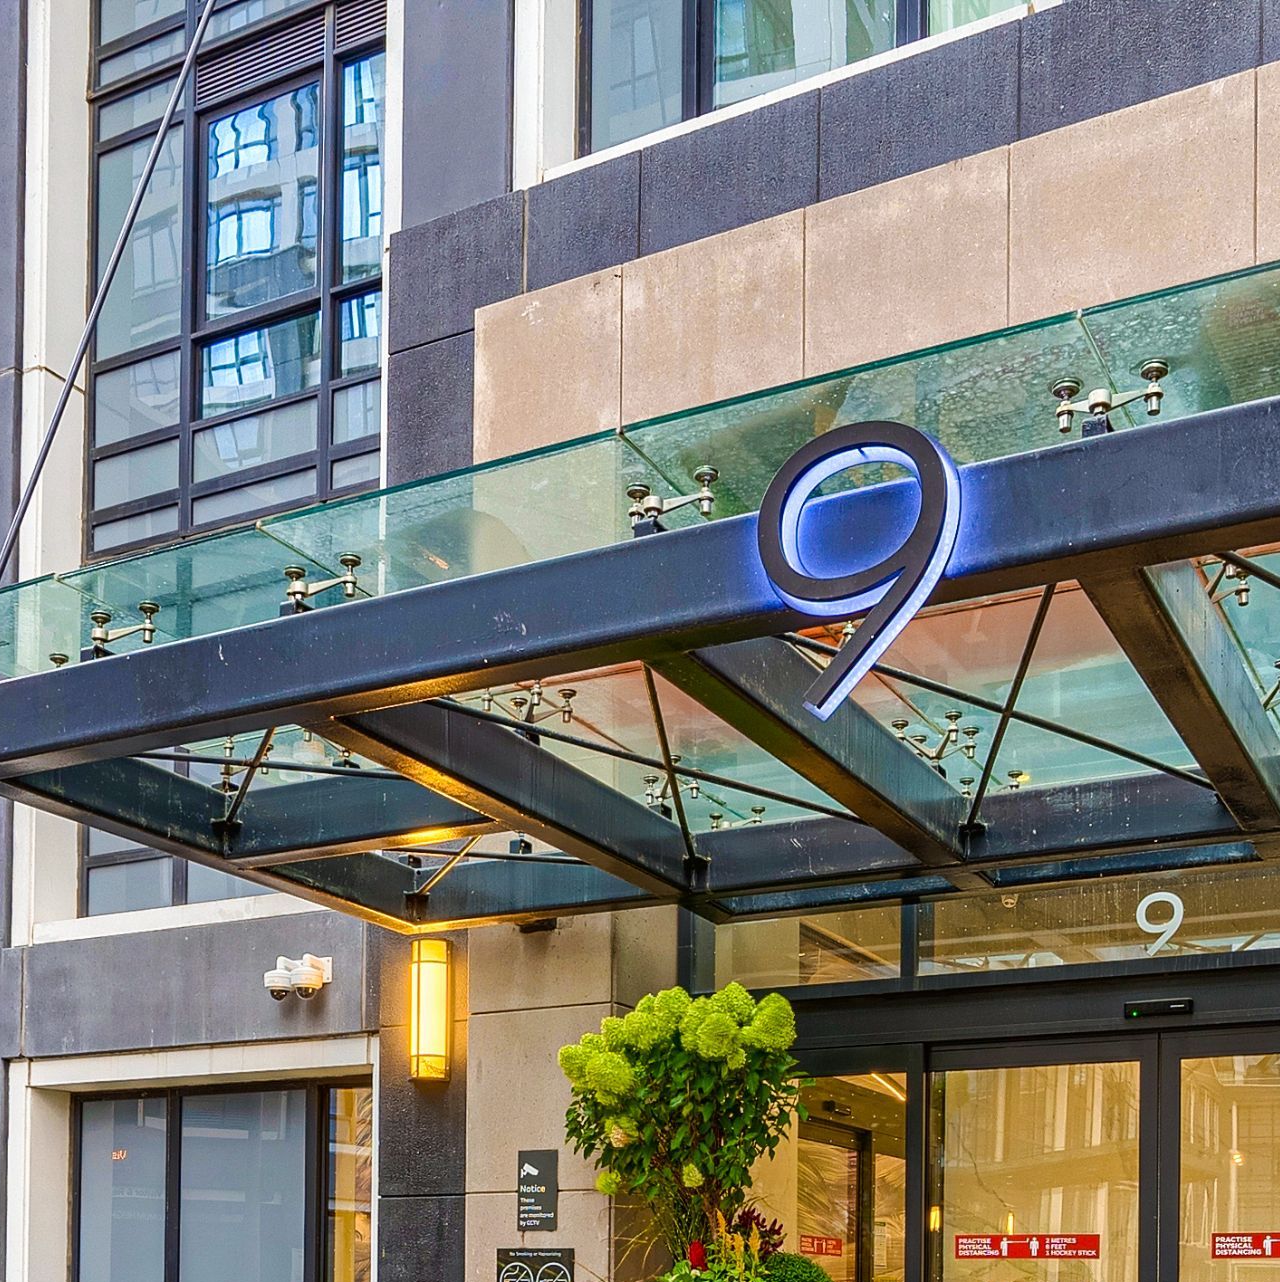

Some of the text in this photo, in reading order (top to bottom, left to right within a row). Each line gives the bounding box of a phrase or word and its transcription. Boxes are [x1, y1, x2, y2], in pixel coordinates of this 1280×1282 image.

[758, 420, 961, 722] 9
[1135, 891, 1184, 957] 9
[520, 1184, 546, 1193] Notice
